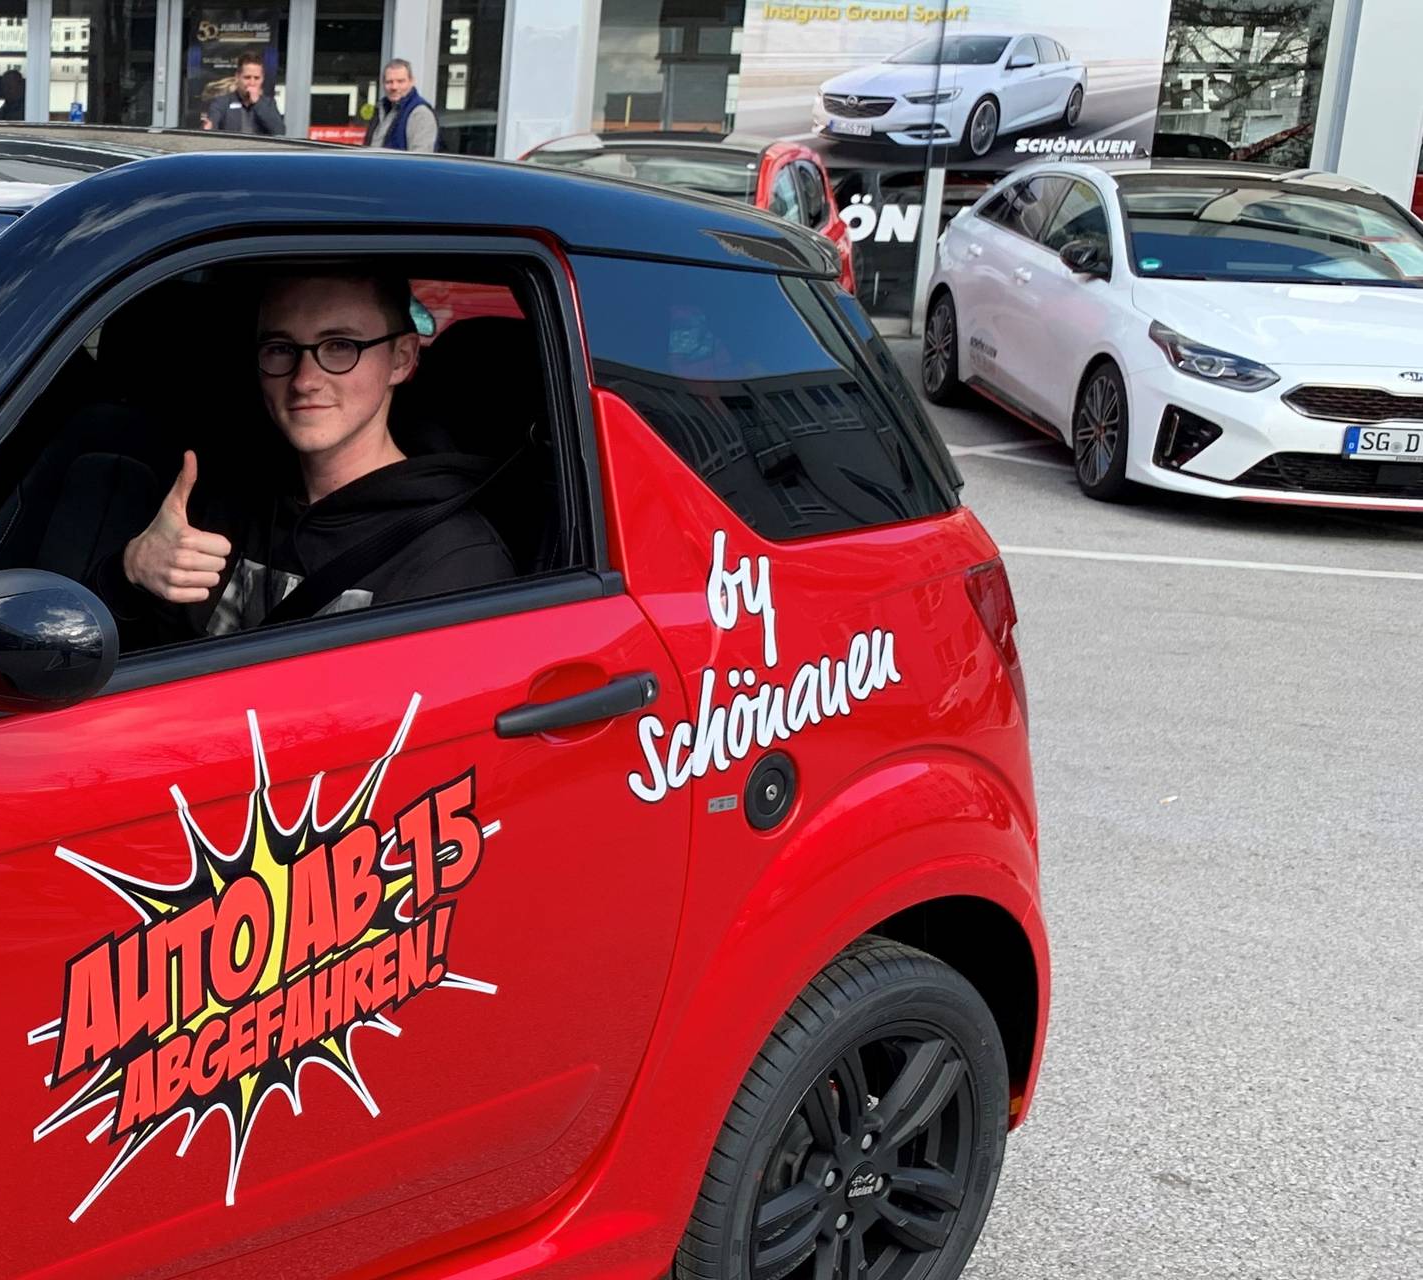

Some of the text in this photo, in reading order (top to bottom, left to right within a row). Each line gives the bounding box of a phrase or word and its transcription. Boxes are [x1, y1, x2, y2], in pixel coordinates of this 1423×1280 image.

[764, 4, 970, 24] Insignia Grand Sport
[1014, 136, 1136, 154] SCHÖNAUEN
[1361, 432, 1420, 452] SG D
[708, 530, 778, 668] by
[628, 629, 902, 802] Schönauen
[57, 774, 482, 1080] AUTO AB 15
[115, 905, 454, 1138] ABGEFAHREN!
